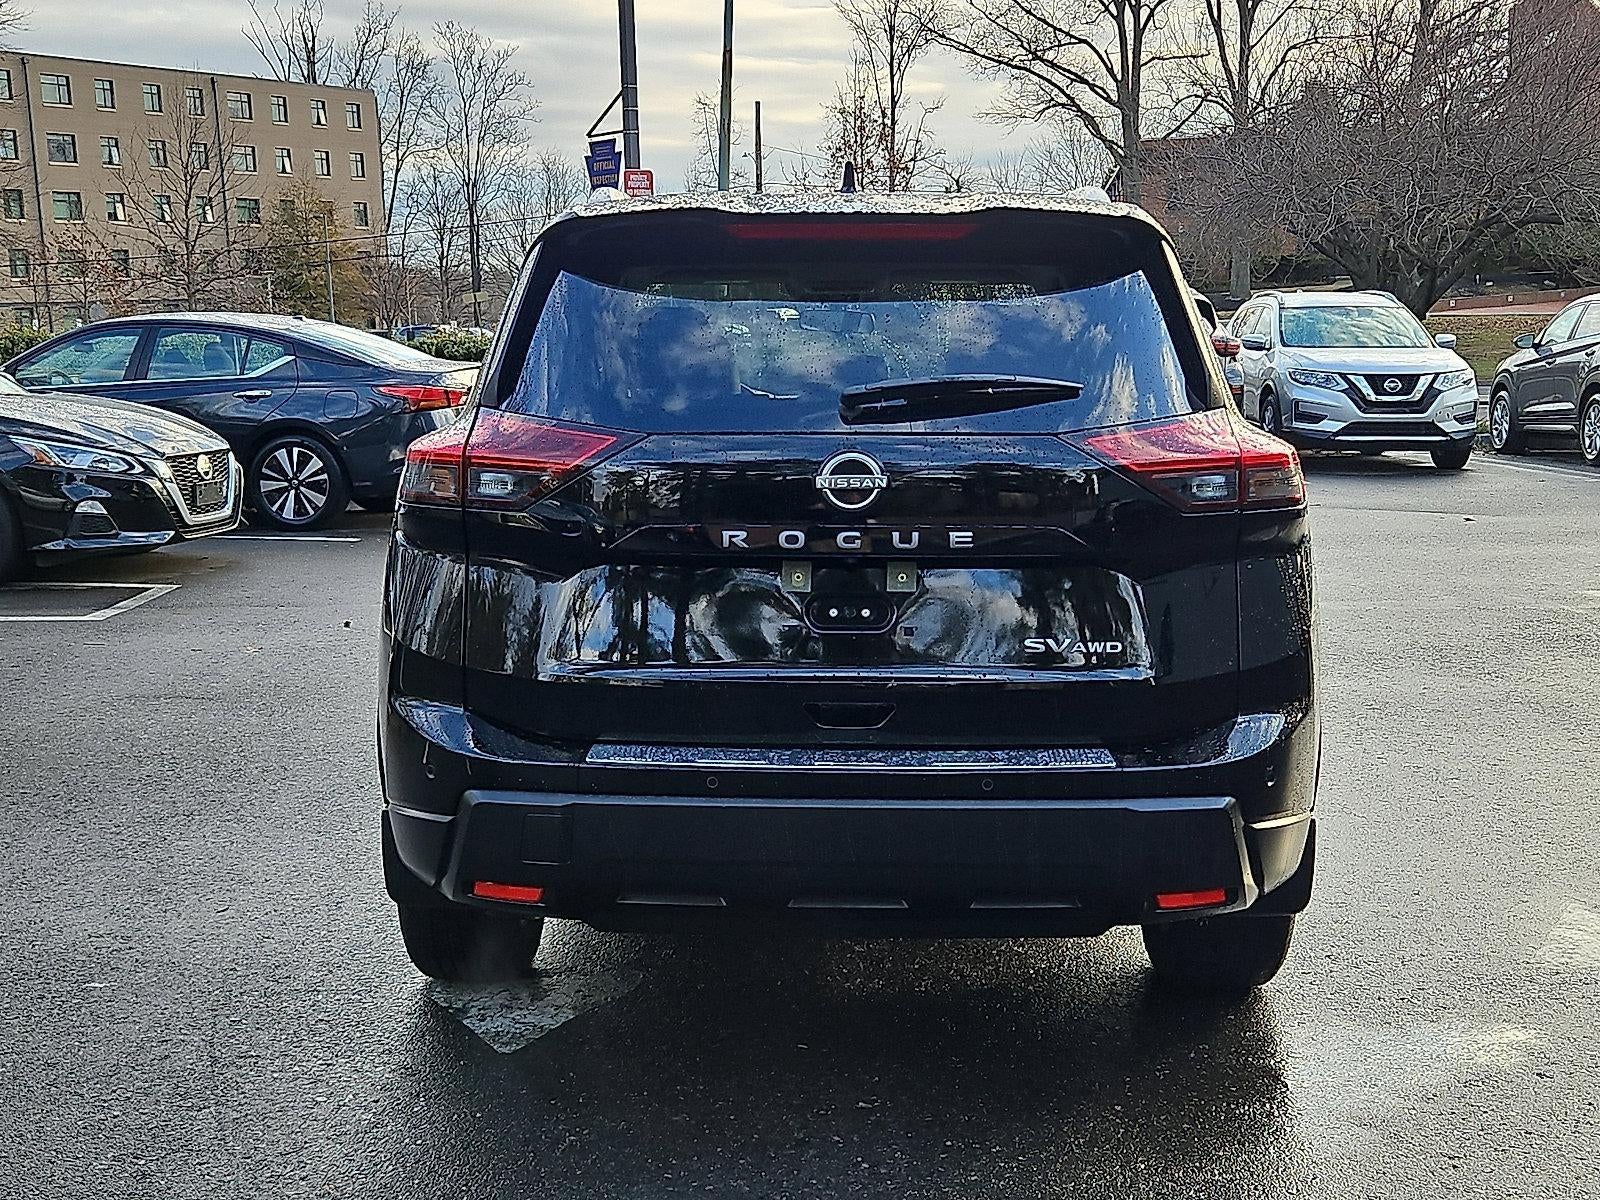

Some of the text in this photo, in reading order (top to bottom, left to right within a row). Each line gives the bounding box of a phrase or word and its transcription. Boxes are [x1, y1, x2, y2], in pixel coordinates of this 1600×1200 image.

[593, 160, 616, 172] OFFICIAL
[591, 174, 618, 186] INSPECTION
[818, 478, 887, 488] NISSAN
[721, 530, 975, 549] ROGUE
[1024, 638, 1122, 653] SV AWD
